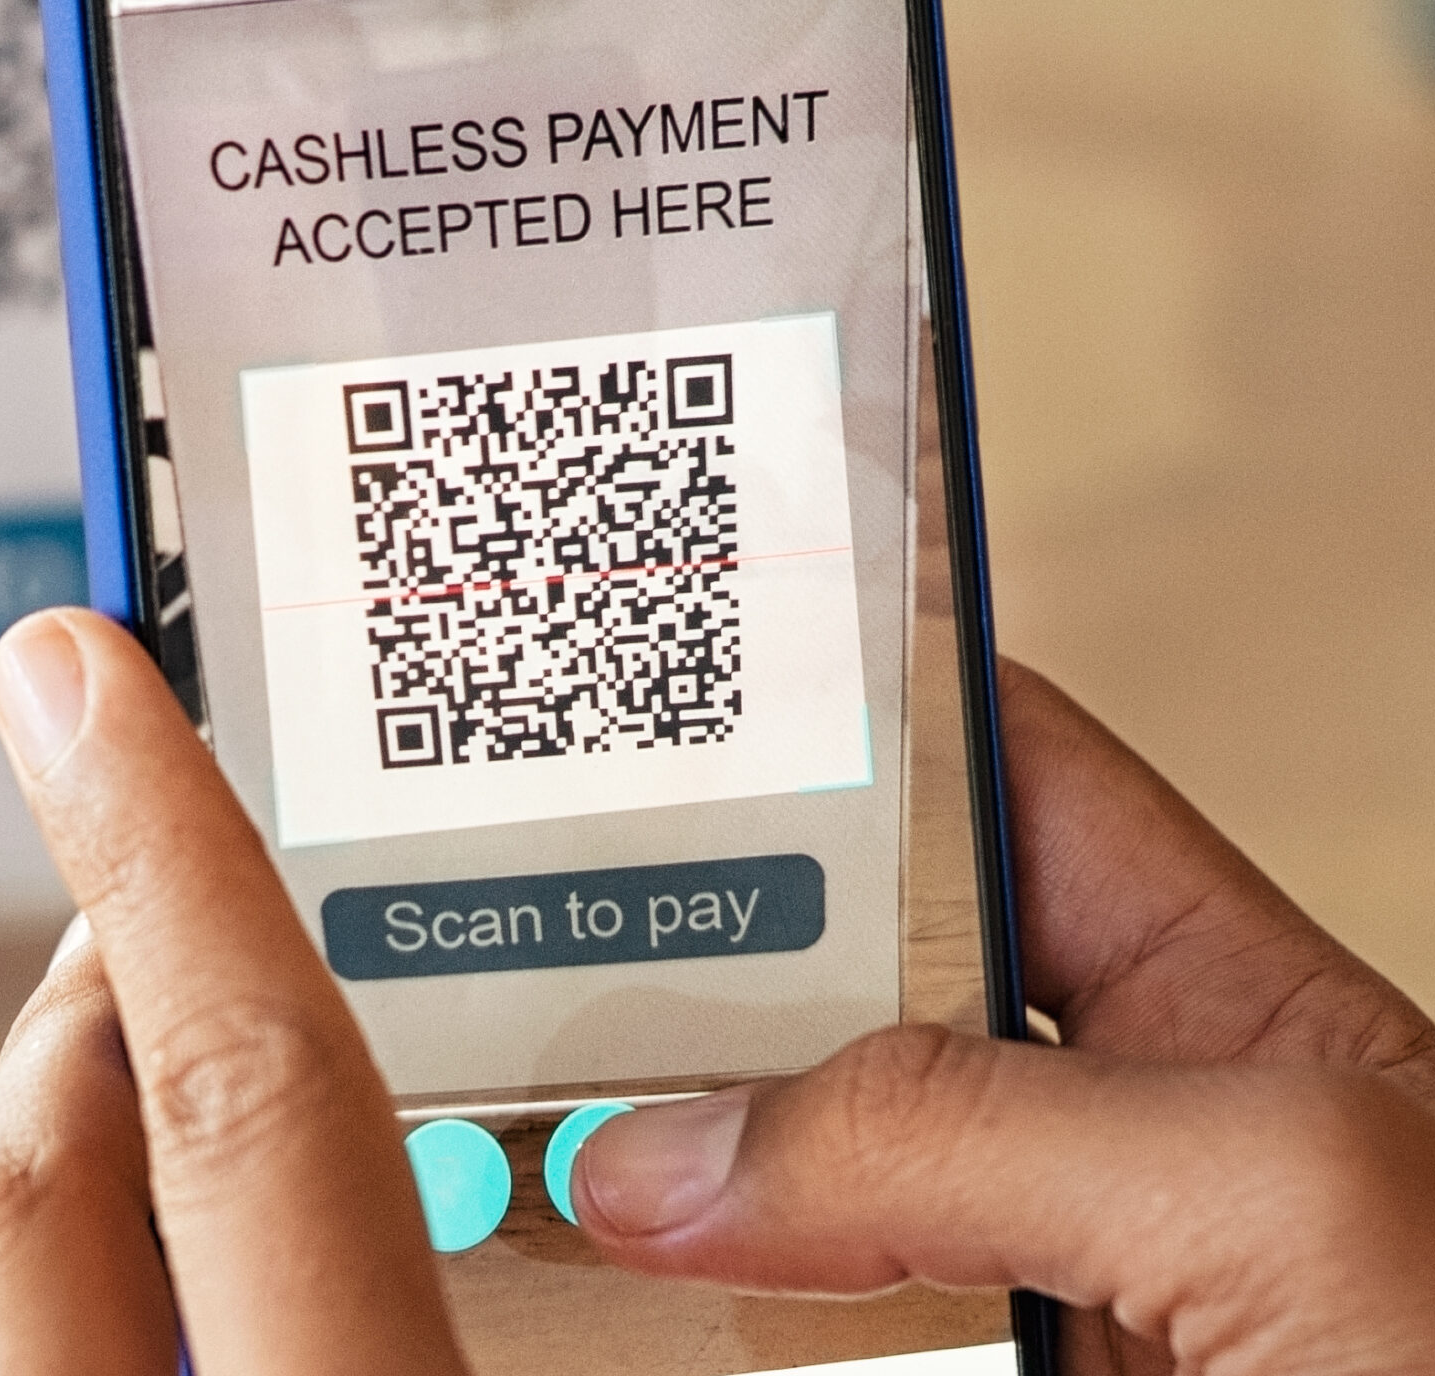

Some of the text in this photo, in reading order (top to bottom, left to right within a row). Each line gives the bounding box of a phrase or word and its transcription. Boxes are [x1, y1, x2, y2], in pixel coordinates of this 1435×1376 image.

[209, 89, 830, 193] CASHLESS PAYMENT
[272, 176, 774, 268] ACCEPTED HERE
[383, 886, 761, 953] Scan to pay
